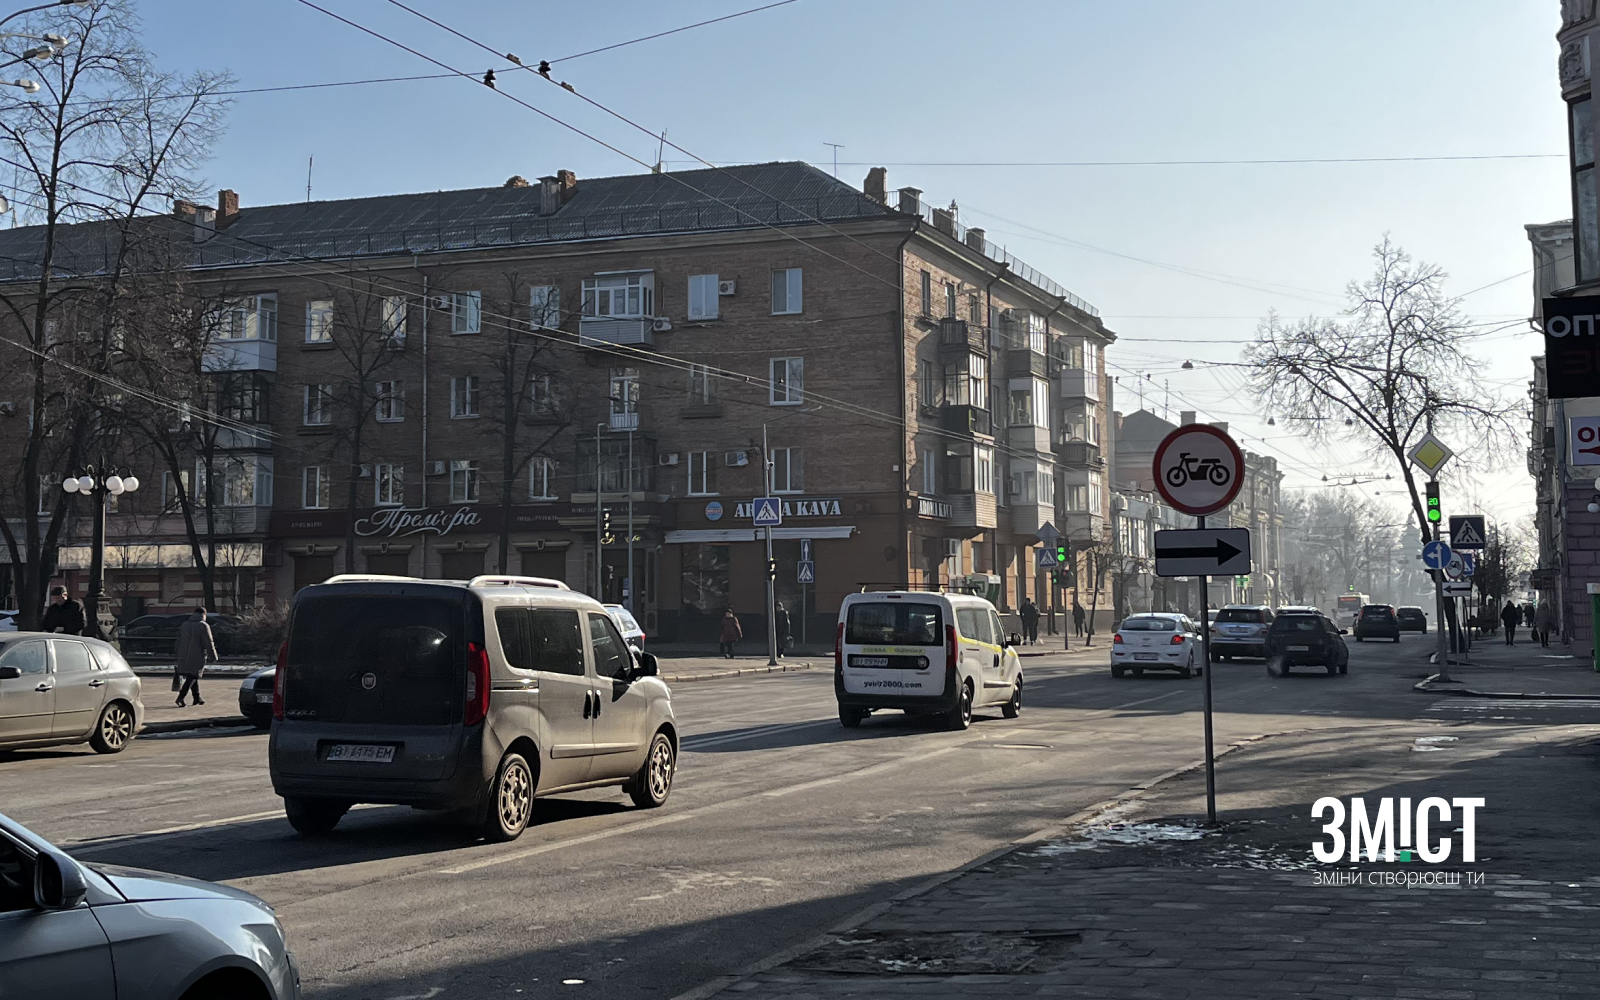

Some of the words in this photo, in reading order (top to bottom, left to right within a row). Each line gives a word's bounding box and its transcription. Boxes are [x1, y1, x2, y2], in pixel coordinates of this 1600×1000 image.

[1547, 314, 1600, 338] ОП
[1578, 427, 1600, 443] О
[733, 500, 792, 518] ARA
[796, 500, 842, 516] KAVA
[1428, 498, 1438, 506] 20
